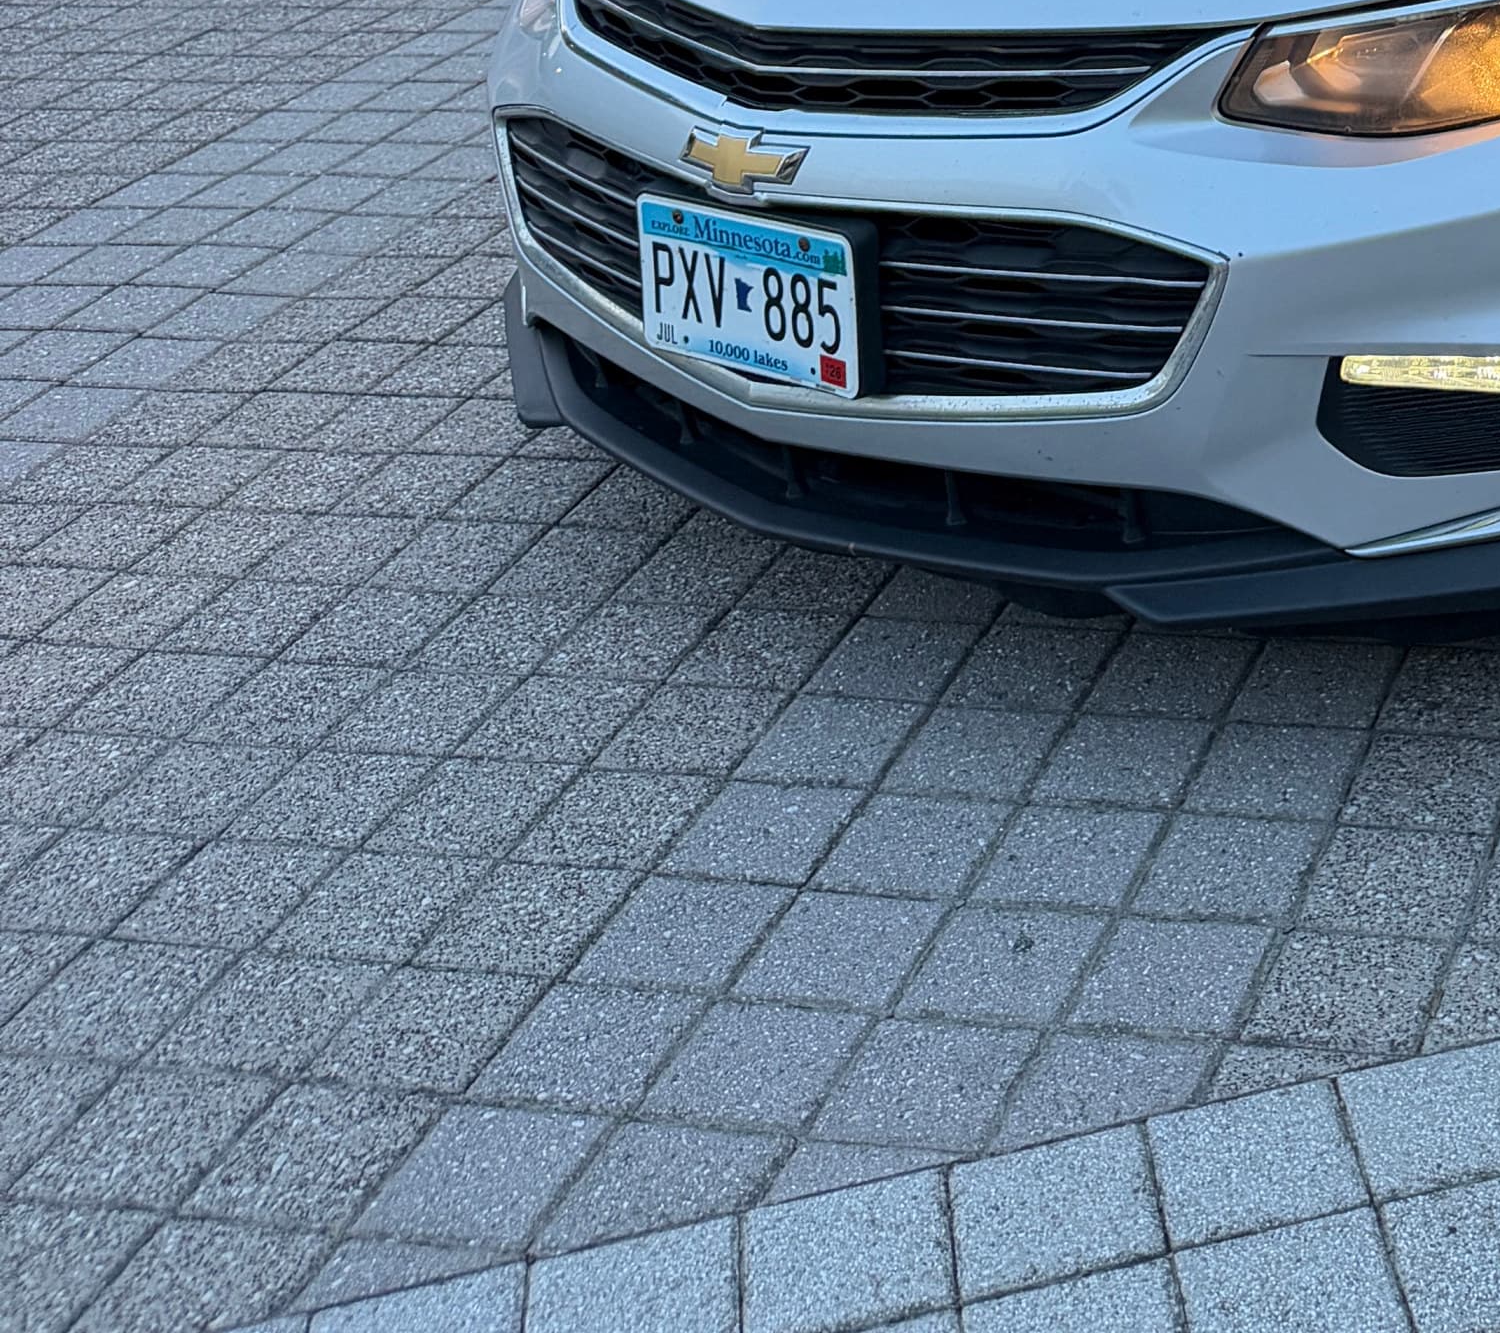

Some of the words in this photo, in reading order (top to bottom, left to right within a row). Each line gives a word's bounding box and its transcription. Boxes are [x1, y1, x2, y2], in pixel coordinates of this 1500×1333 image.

[652, 241, 725, 329] PXV
[762, 266, 841, 355] 885
[656, 322, 678, 345] JUL
[709, 339, 750, 362] 10,000
[753, 349, 788, 371] lakes
